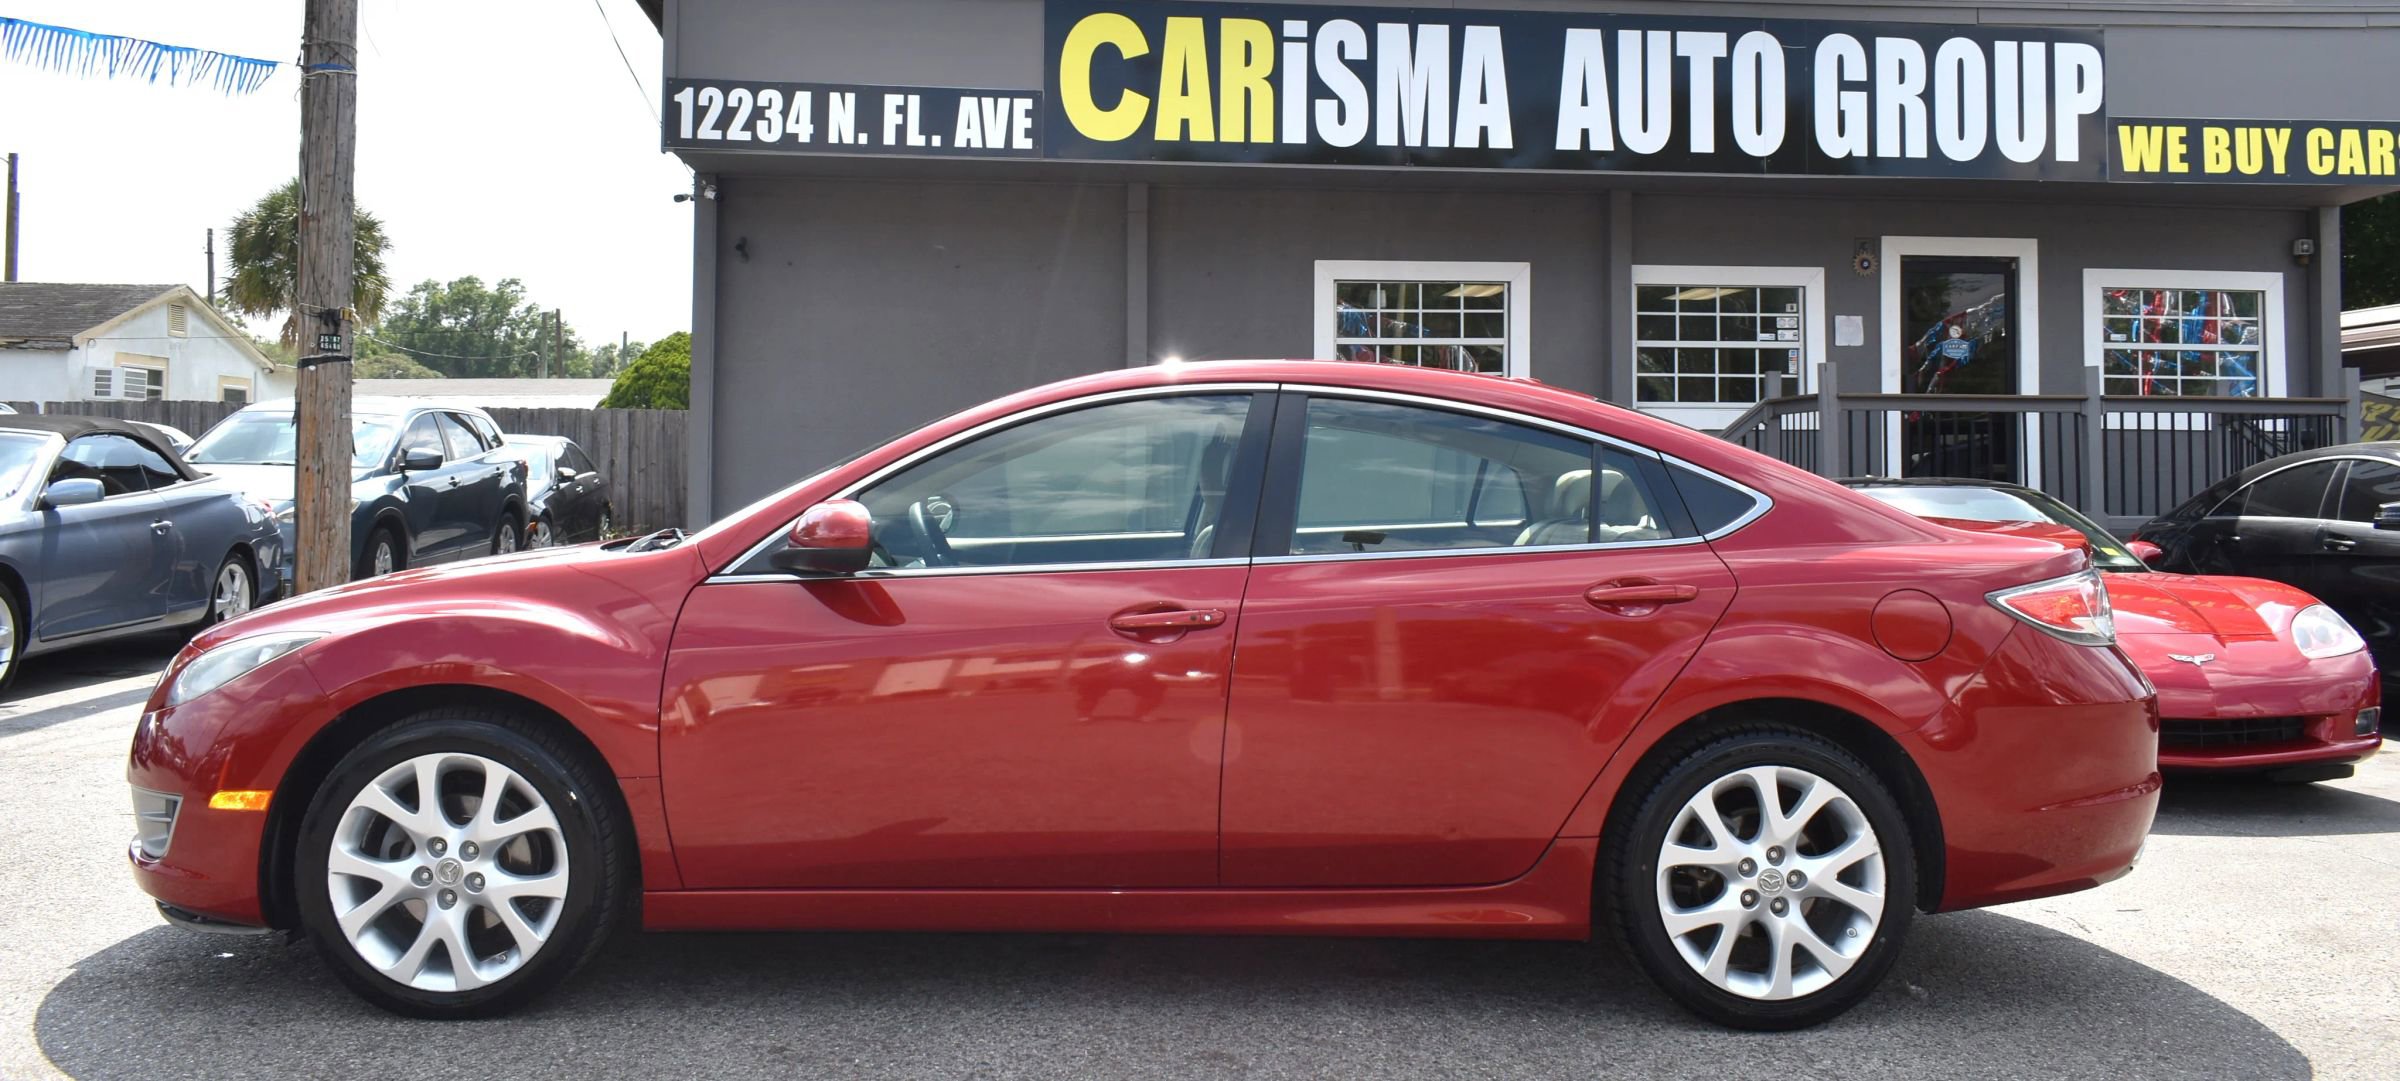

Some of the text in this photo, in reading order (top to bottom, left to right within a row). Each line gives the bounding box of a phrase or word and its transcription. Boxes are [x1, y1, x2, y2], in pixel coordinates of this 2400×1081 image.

[674, 87, 1033, 150] 12234 N. FL. AVE
[1556, 28, 1786, 156] AUTO
[1814, 33, 2104, 163] GROUP
[2118, 125, 2400, 176] WE BUY CAR
